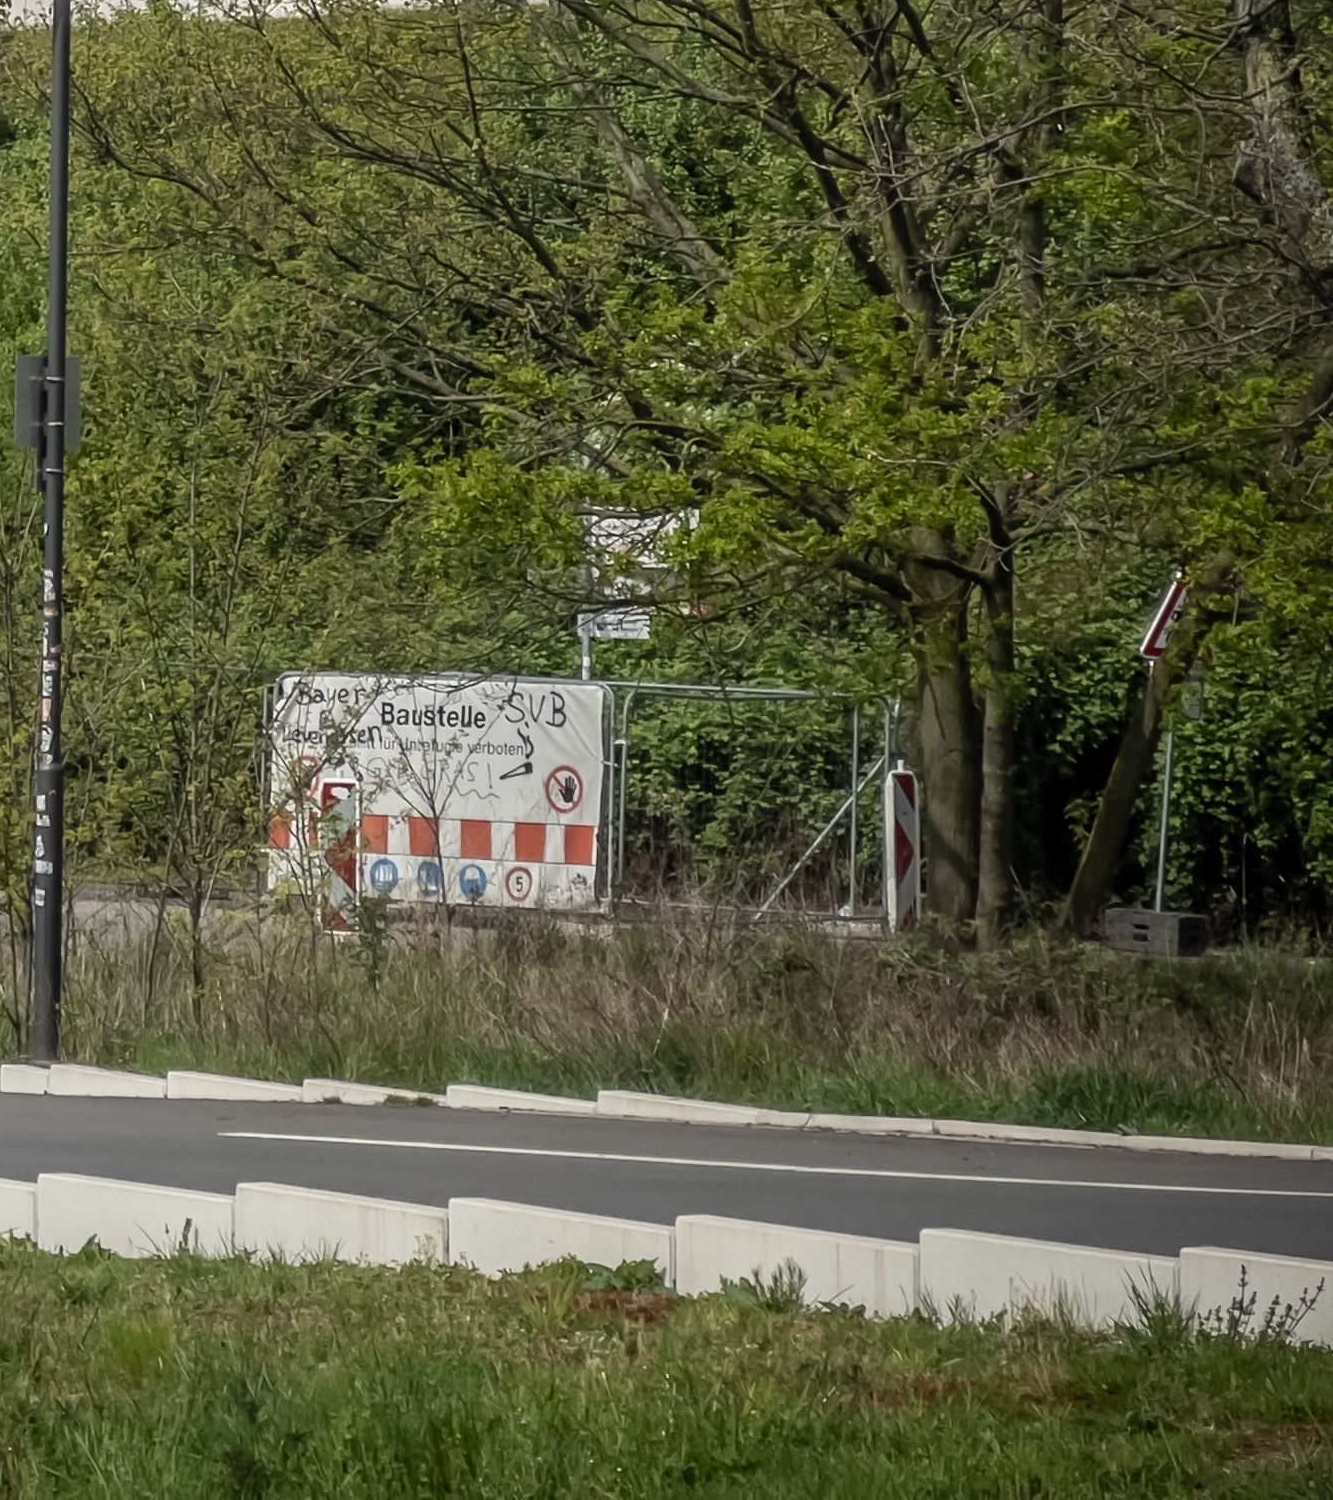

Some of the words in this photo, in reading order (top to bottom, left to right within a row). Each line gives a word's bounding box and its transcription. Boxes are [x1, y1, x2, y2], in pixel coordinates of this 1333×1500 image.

[382, 702, 487, 729] Baustelle
[504, 691, 568, 728] SVB
[515, 876, 524, 893] 5
